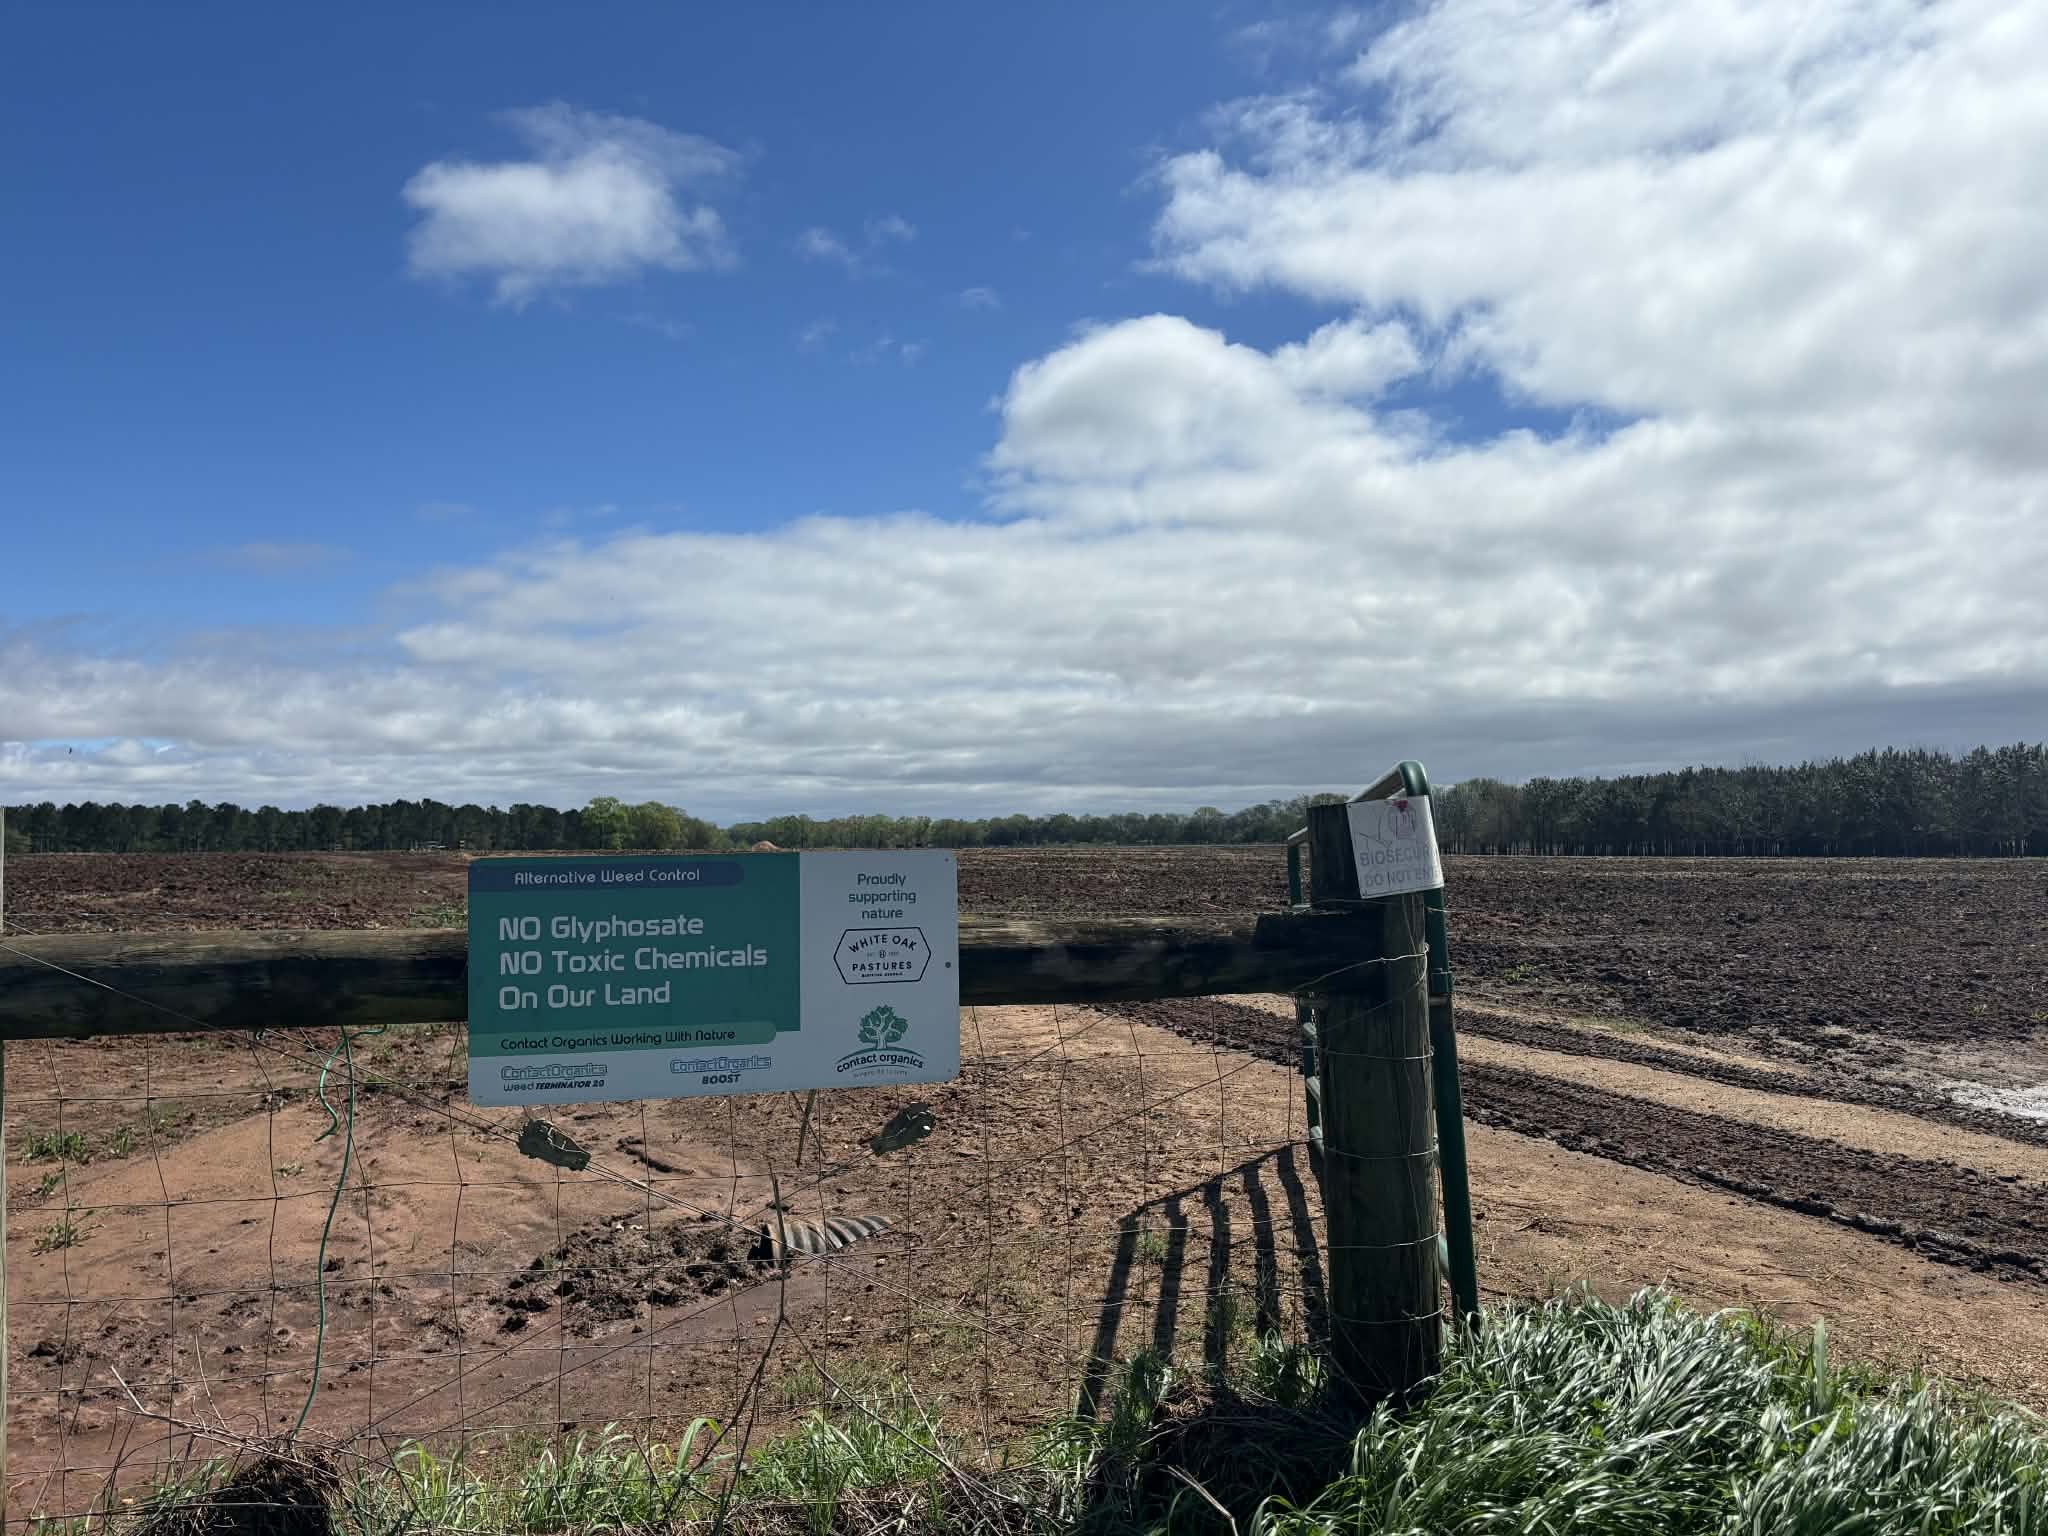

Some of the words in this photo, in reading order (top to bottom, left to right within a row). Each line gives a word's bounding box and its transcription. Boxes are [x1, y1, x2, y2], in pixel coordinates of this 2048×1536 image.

[514, 871, 596, 885] Alternative
[601, 869, 644, 883] Weed
[649, 868, 700, 882] Control
[857, 873, 906, 887] Proudly
[849, 889, 916, 905] supporting
[862, 909, 903, 920] nature
[499, 916, 541, 941] NO
[551, 914, 704, 944] Glyphosate
[849, 934, 888, 953] WHITE
[892, 935, 917, 951] OAK
[500, 951, 542, 975] NO
[551, 950, 625, 973] Toxic
[634, 944, 768, 970] Chemicals
[852, 961, 912, 972] PASTURES
[499, 986, 538, 1010] On
[547, 984, 596, 1008] Our
[605, 981, 671, 1006] Land
[501, 1037, 548, 1050] Contact
[552, 1035, 607, 1050] Organics
[611, 1032, 662, 1047] Working
[665, 1031, 692, 1043] With
[696, 1029, 735, 1041] Nature
[837, 1053, 877, 1073] contact
[879, 1053, 924, 1069] organics
[535, 1080, 591, 1090] TERMINATOR
[701, 1073, 741, 1085] BOOST
